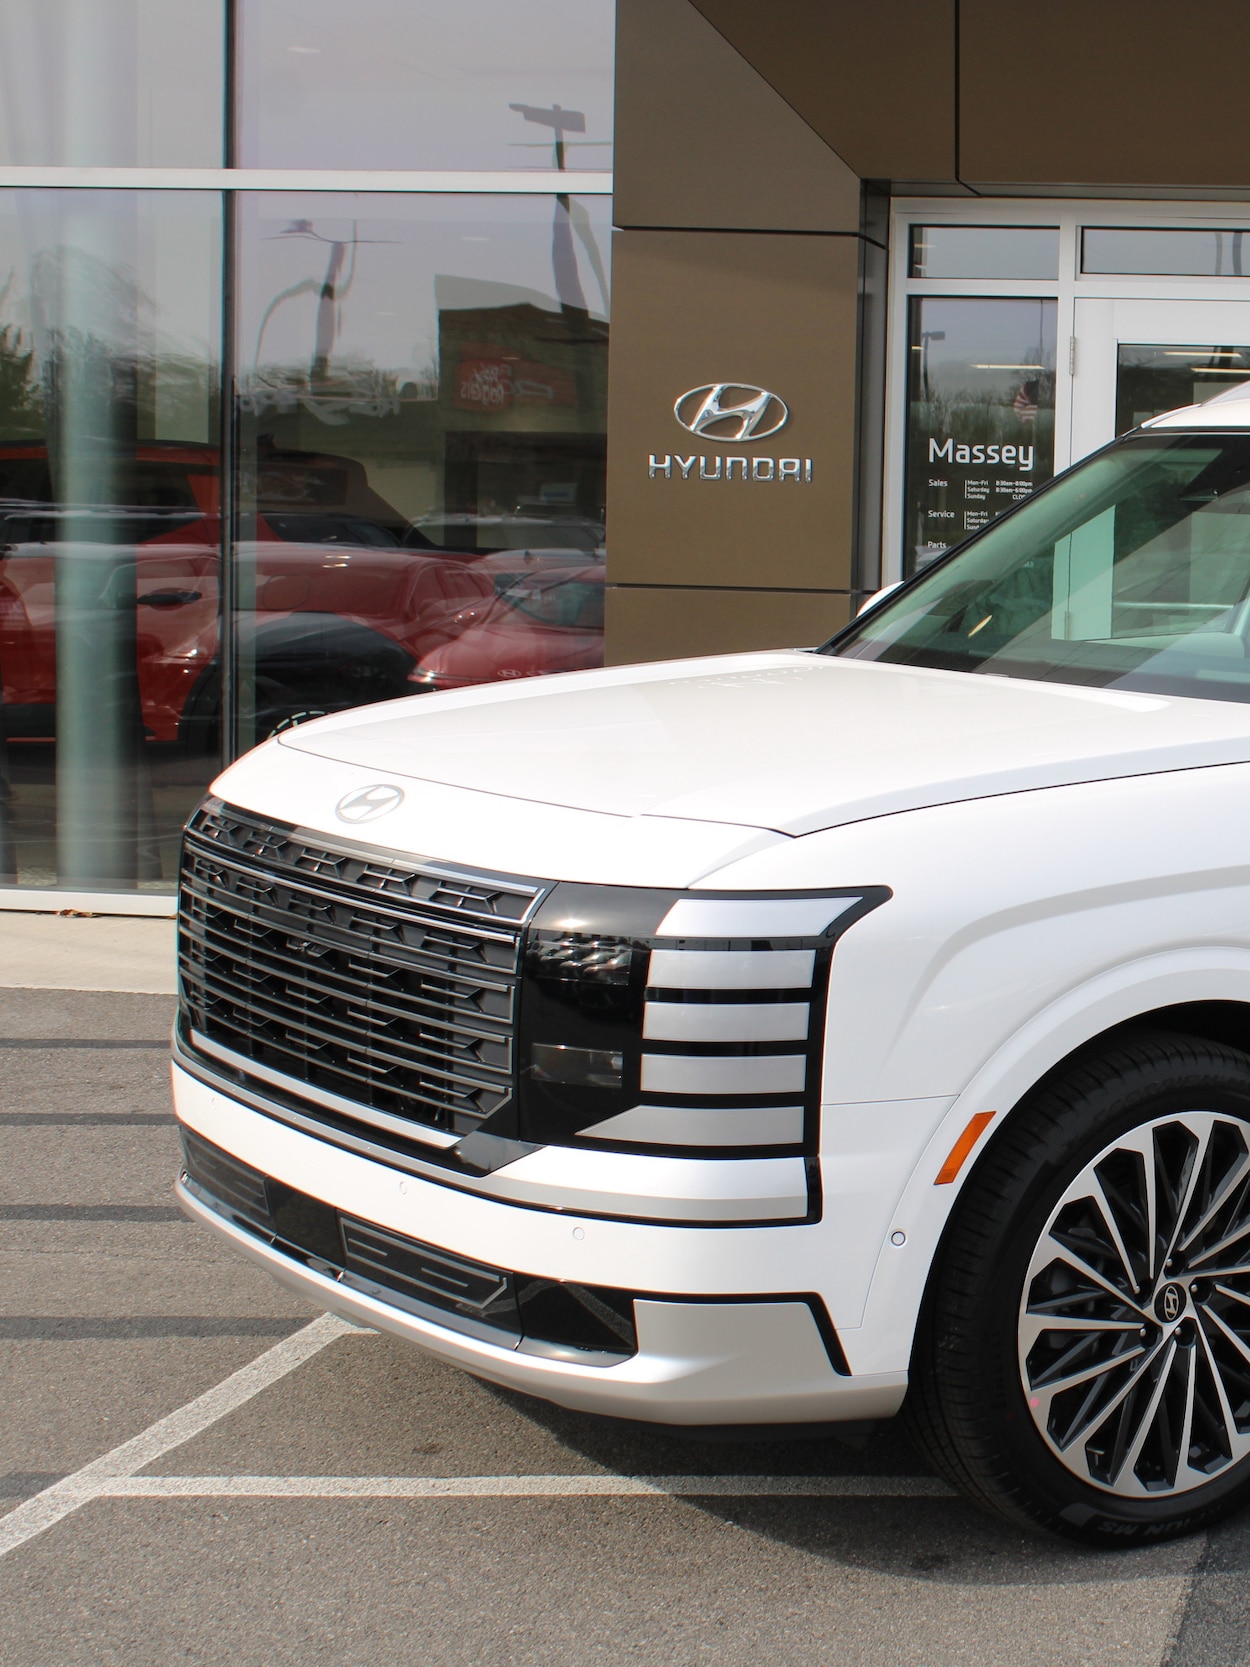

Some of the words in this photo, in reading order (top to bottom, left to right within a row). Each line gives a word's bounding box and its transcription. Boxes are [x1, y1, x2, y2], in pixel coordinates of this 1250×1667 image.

[928, 437, 1035, 472] Massey
[647, 453, 813, 484] HYUNDAI
[928, 479, 949, 488] Sales
[967, 486, 991, 494] Saturday
[966, 493, 987, 501] Sunday
[927, 510, 955, 519] Service
[927, 541, 947, 550] Parts
